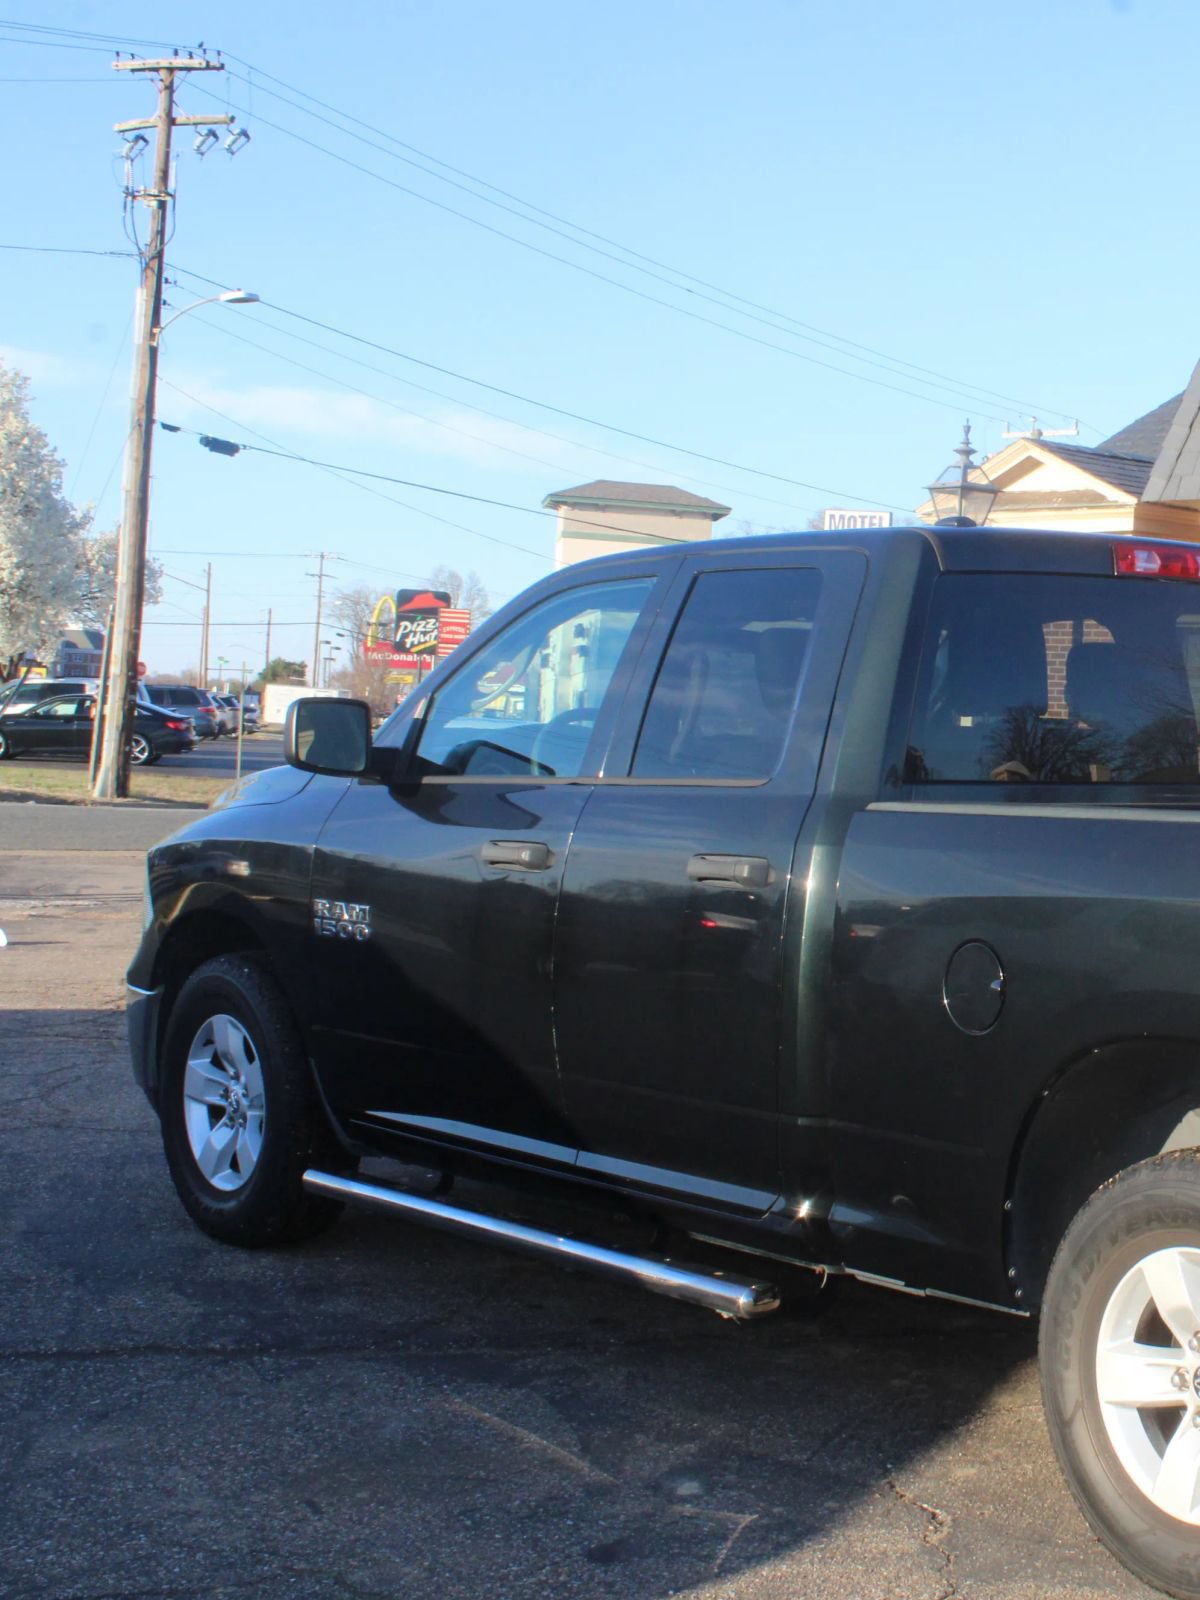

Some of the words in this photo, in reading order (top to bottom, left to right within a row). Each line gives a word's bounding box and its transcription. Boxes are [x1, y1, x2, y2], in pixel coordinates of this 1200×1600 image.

[396, 617, 438, 641] Pizz
[405, 628, 438, 648] Hut
[313, 899, 369, 922] RAM
[313, 918, 369, 940] 1500
